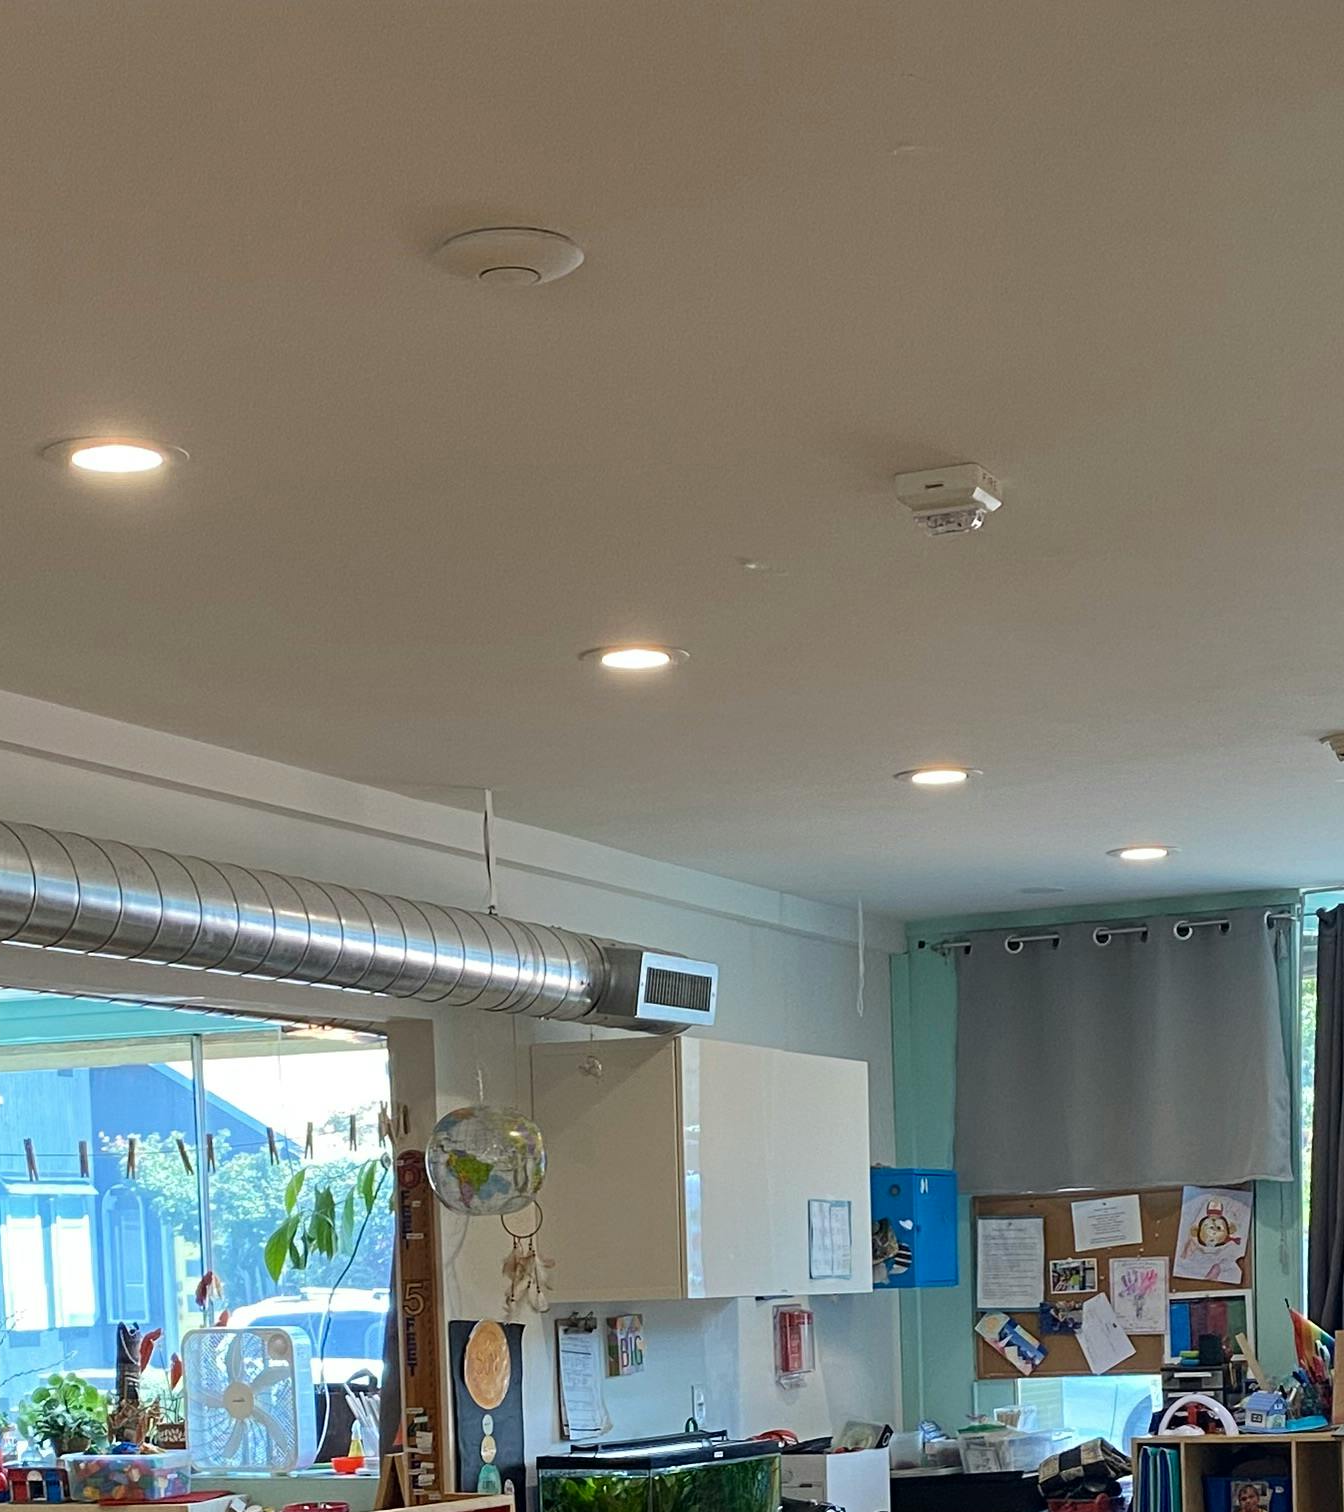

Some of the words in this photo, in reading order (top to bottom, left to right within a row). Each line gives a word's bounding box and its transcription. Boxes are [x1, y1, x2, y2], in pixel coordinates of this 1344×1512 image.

[404, 1283, 424, 1316] 5
[406, 1317, 417, 1377] FEET
[620, 1335, 643, 1368] BIG
